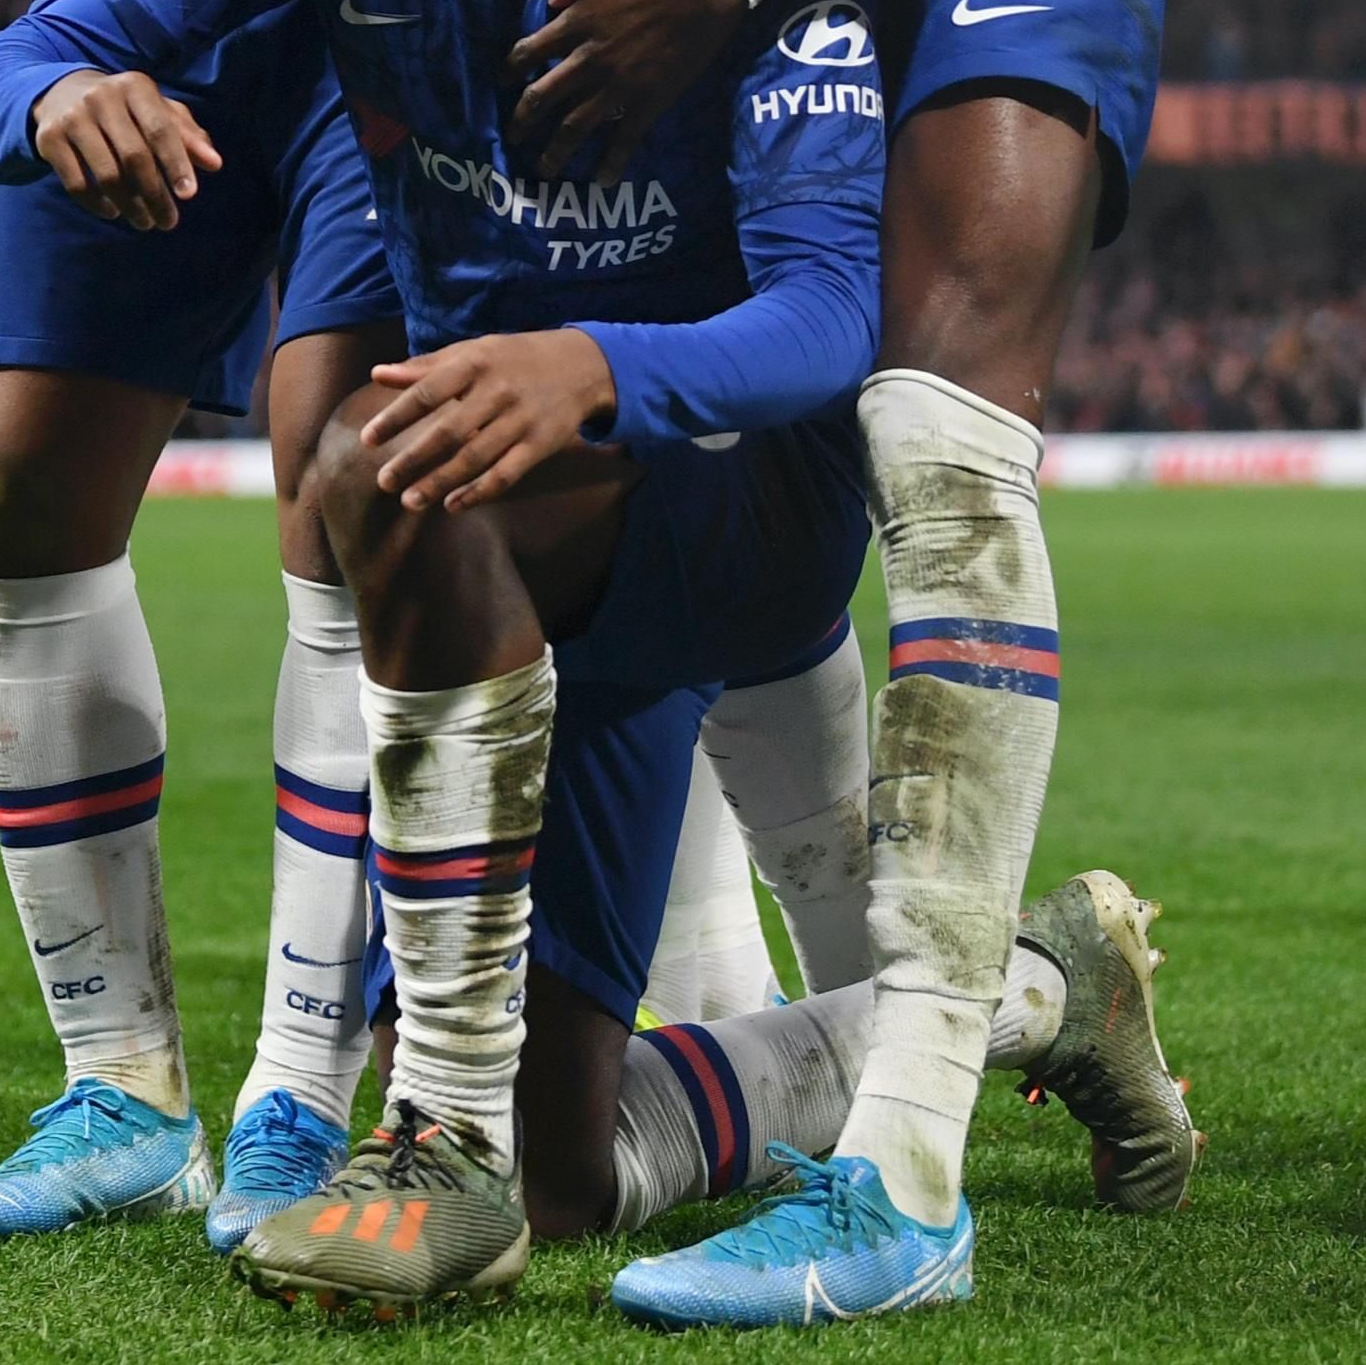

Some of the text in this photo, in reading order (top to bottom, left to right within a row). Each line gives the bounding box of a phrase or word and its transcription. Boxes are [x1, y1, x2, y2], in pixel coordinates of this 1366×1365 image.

[751, 84, 884, 124] HYUNDA
[411, 134, 679, 230] YOKOHAMA
[547, 223, 677, 271] TYRES
[867, 822, 909, 846] FC
[51, 975, 106, 1000] CFC
[286, 989, 346, 1021] CFC
